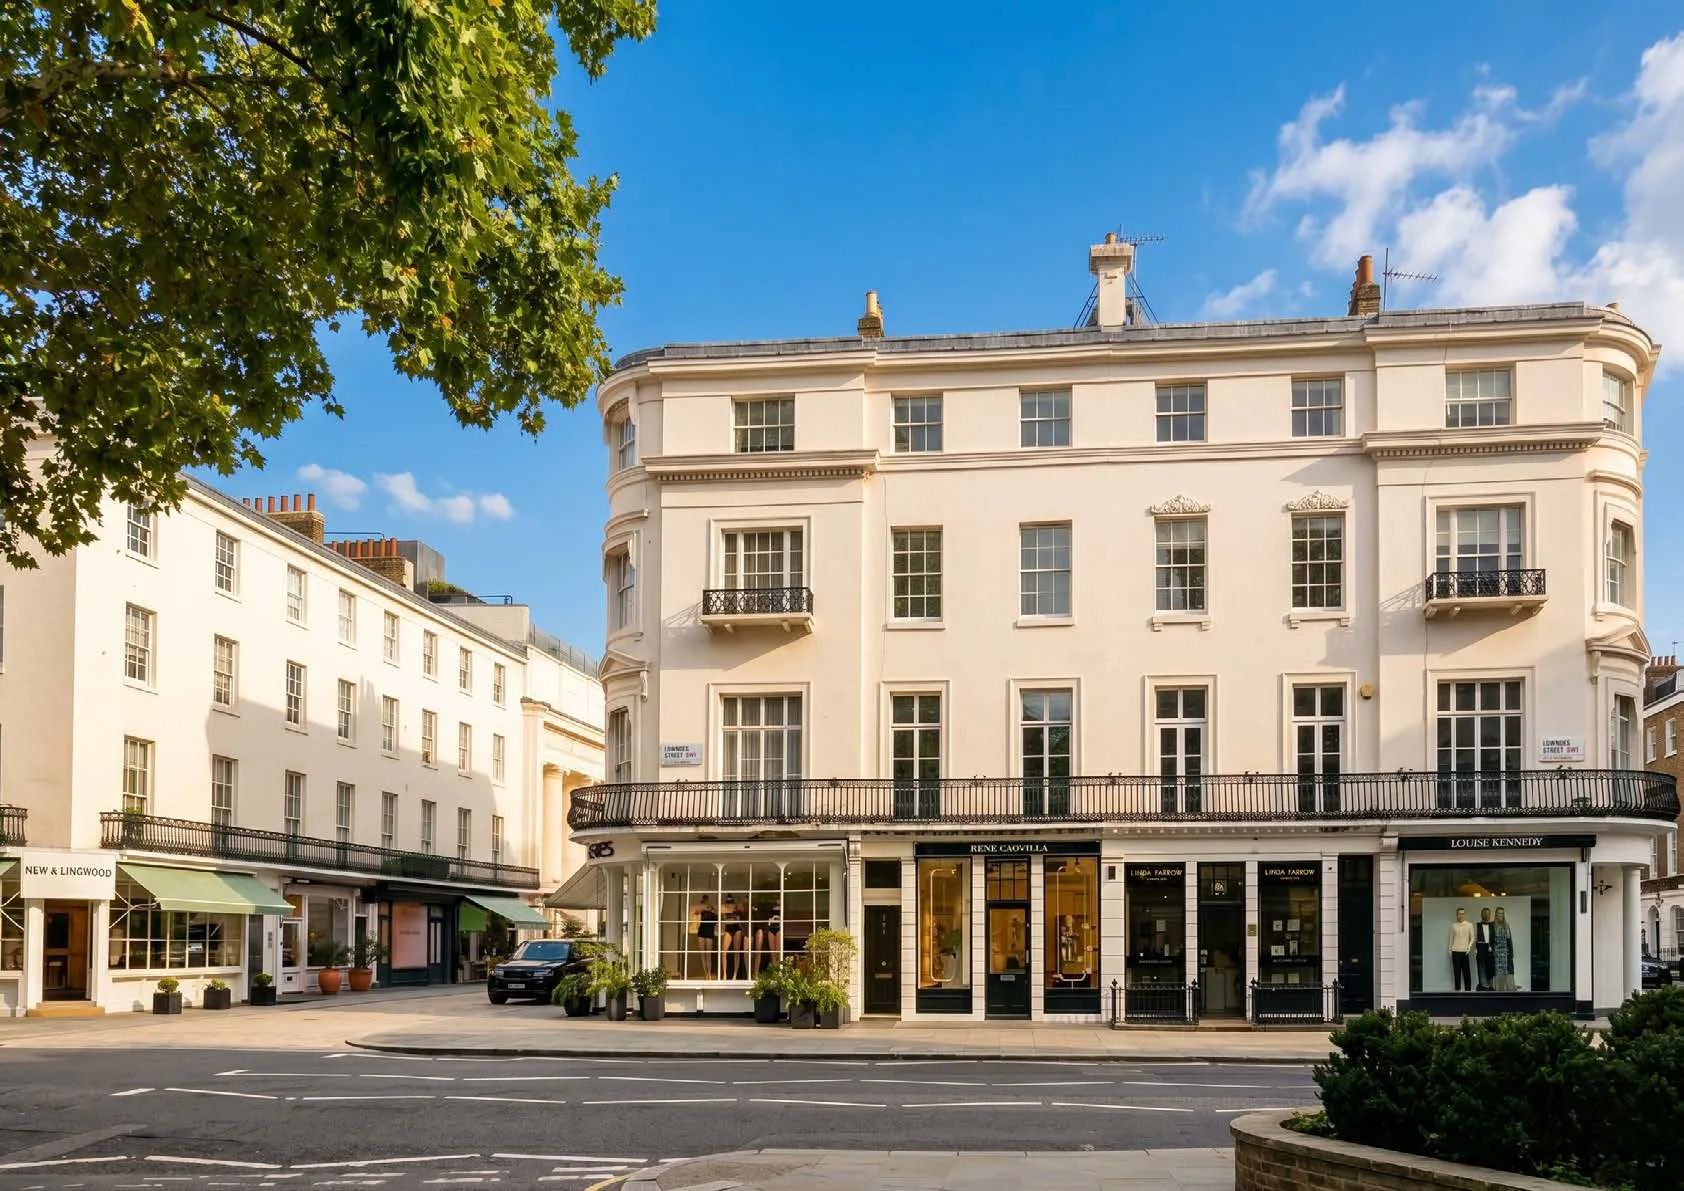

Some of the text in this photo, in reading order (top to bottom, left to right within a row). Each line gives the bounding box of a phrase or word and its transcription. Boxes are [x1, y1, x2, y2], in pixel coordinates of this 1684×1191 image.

[1451, 837, 1543, 848] LOUISE KENNEDY
[971, 844, 1048, 853] RENE CAOVILLA
[25, 865, 112, 877] NEW & LINGWOOD
